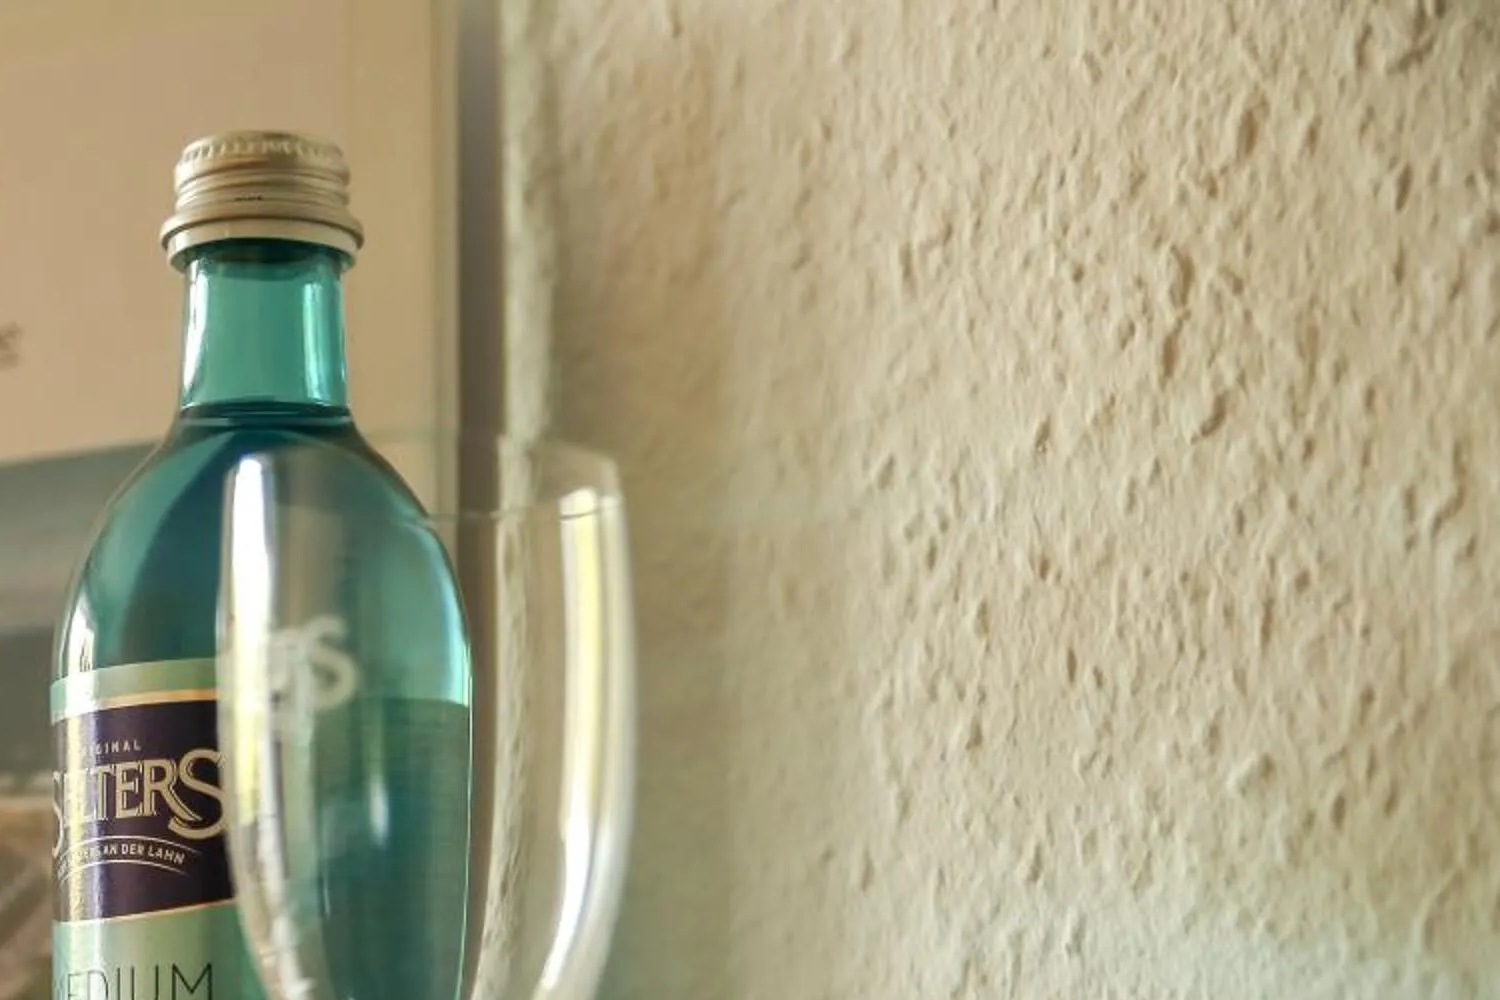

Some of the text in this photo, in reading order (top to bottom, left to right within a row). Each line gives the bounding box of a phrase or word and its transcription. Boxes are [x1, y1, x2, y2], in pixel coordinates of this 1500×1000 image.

[80, 739, 142, 757] RIGINAL
[103, 844, 118, 856] AN
[120, 843, 145, 856] DER
[147, 844, 186, 865] LAHN
